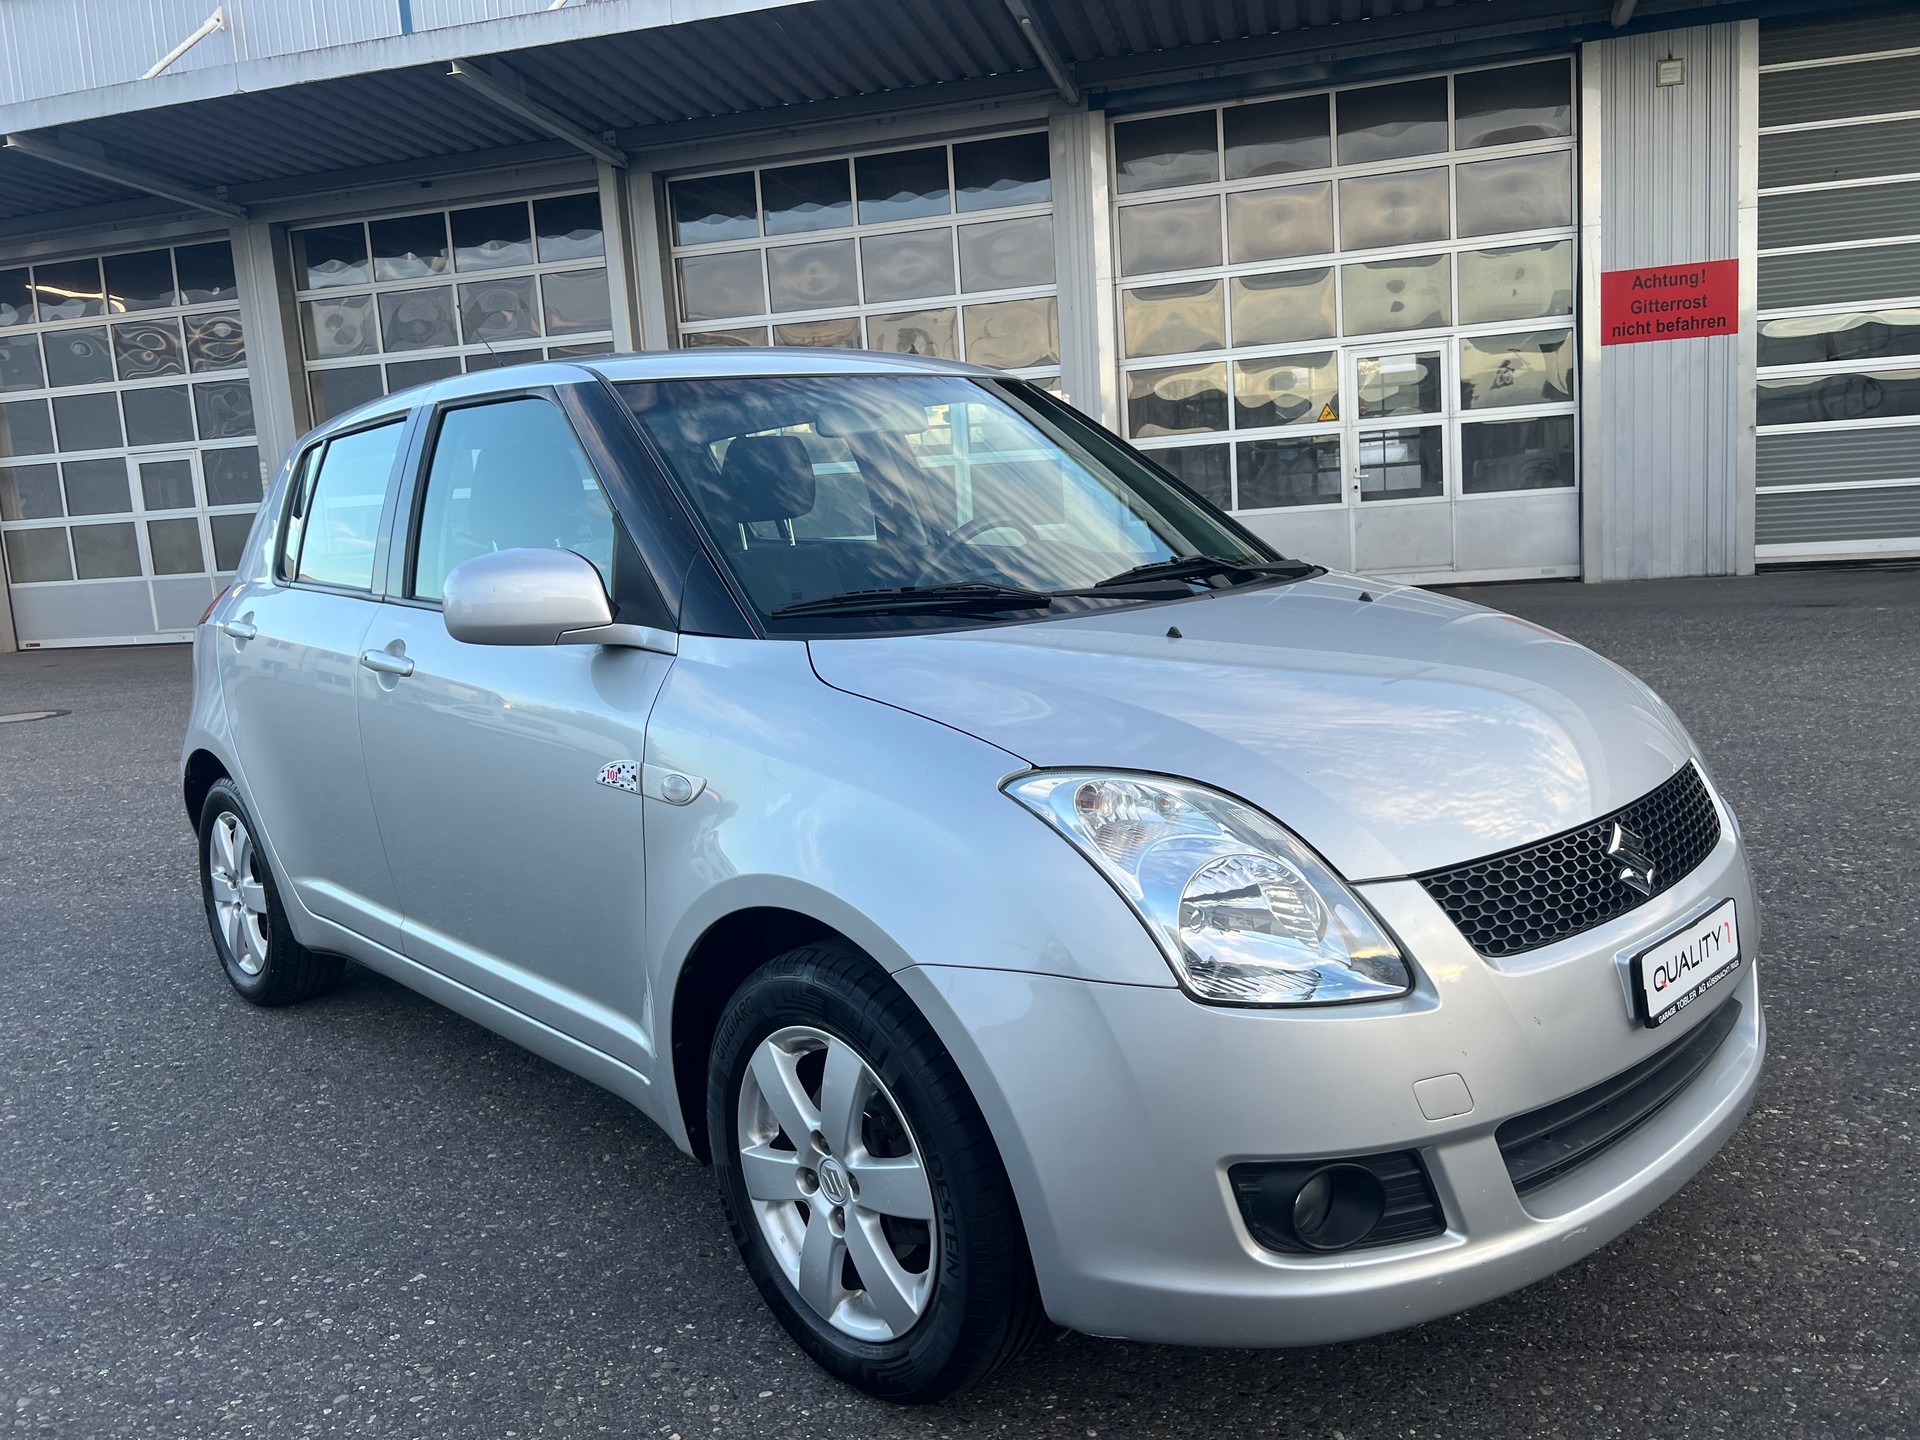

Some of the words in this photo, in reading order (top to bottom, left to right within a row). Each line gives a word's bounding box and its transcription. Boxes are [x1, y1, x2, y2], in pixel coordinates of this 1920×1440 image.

[1630, 294, 1708, 315] Gitterrost
[1612, 320, 1651, 337] nicht
[1656, 315, 1726, 333] befahren
[1658, 1005, 1676, 1024] GARAGE
[1676, 989, 1697, 1010] TOBLER
[1698, 977, 1706, 995] AG
